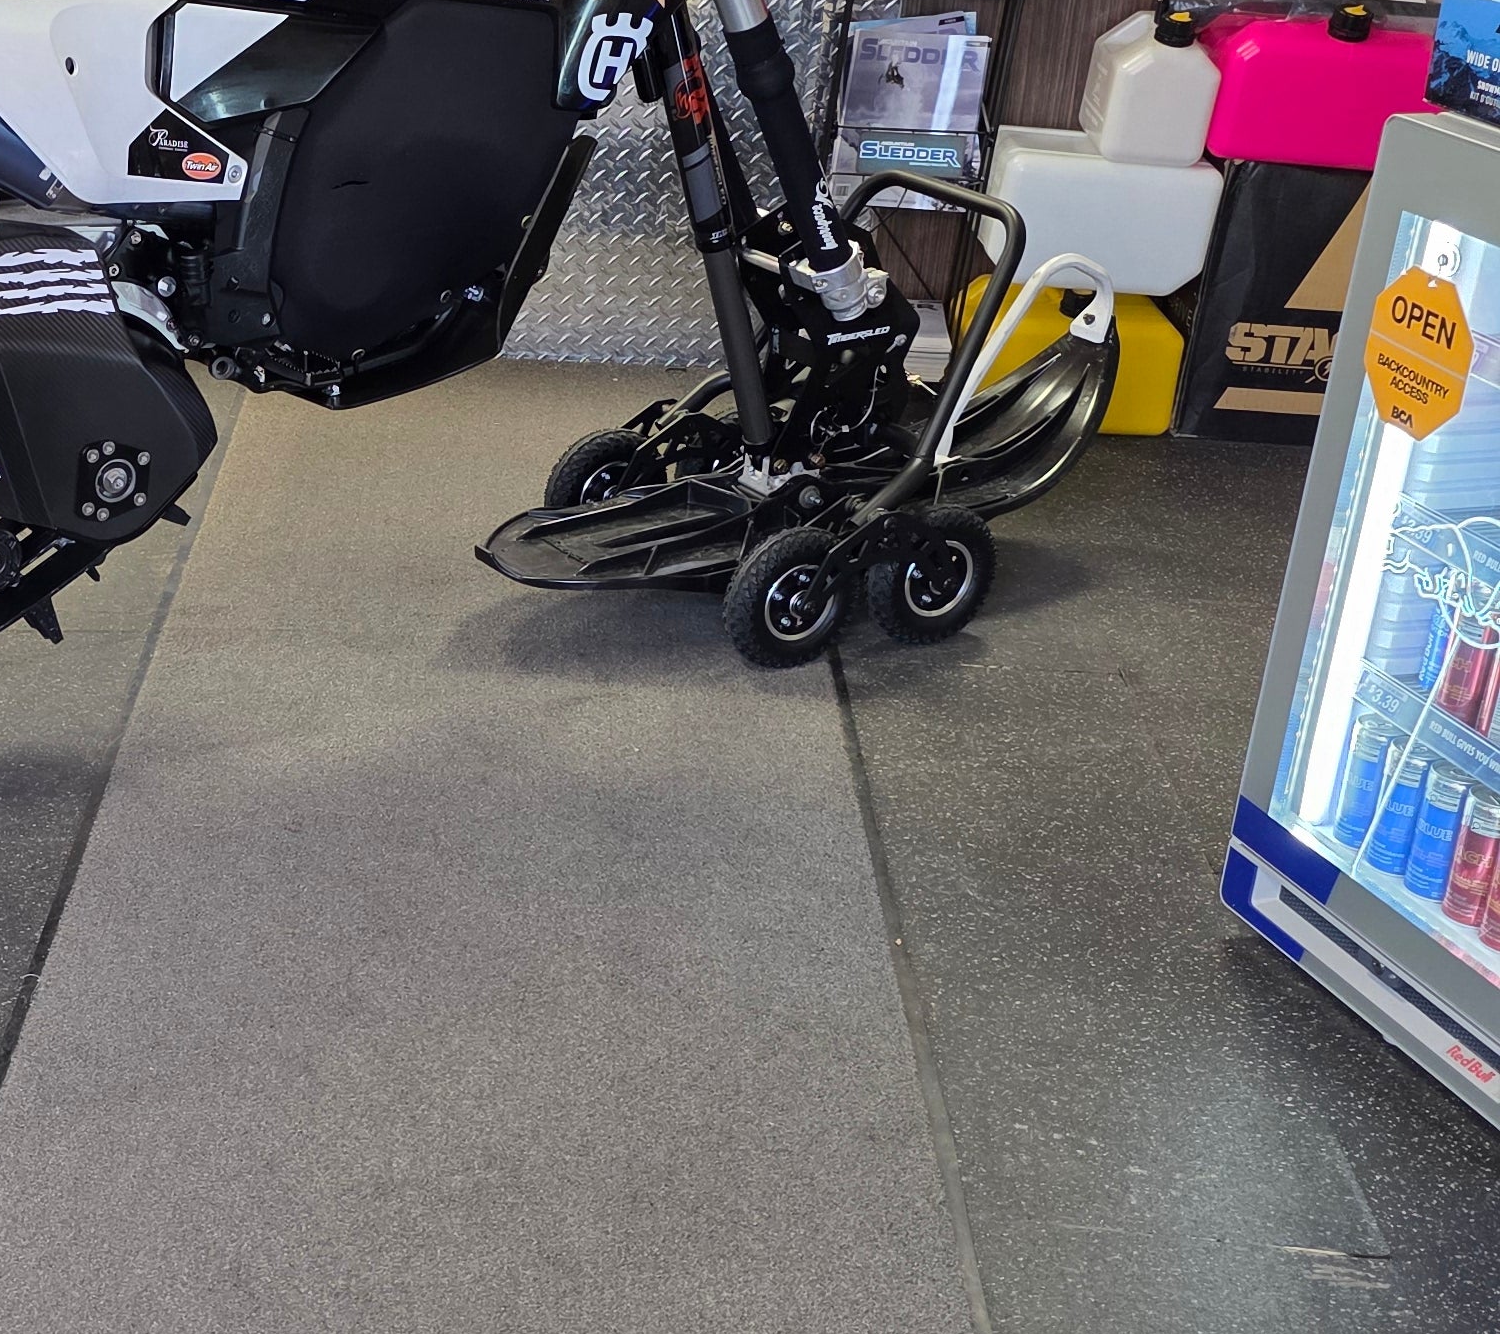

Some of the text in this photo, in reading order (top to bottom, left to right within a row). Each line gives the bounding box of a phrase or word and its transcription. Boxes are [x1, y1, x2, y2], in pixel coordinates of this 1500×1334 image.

[1467, 49, 1491, 69] WIDE
[1469, 90, 1479, 101] KIT
[186, 160, 219, 172] Twin Air
[859, 140, 962, 168] SLEDDER
[826, 326, 891, 346] TIMBERSLED
[1391, 294, 1457, 350] OPEN
[1377, 352, 1450, 399] BACKCOUNTRY
[1389, 376, 1429, 405] ACCESS
[1391, 405, 1414, 428] BCA
[1368, 683, 1400, 713] $3.39
[1429, 721, 1442, 737] RED
[1441, 727, 1457, 747] BULL
[1456, 738, 1476, 757] GIVES
[1475, 749, 1491, 767] YOU
